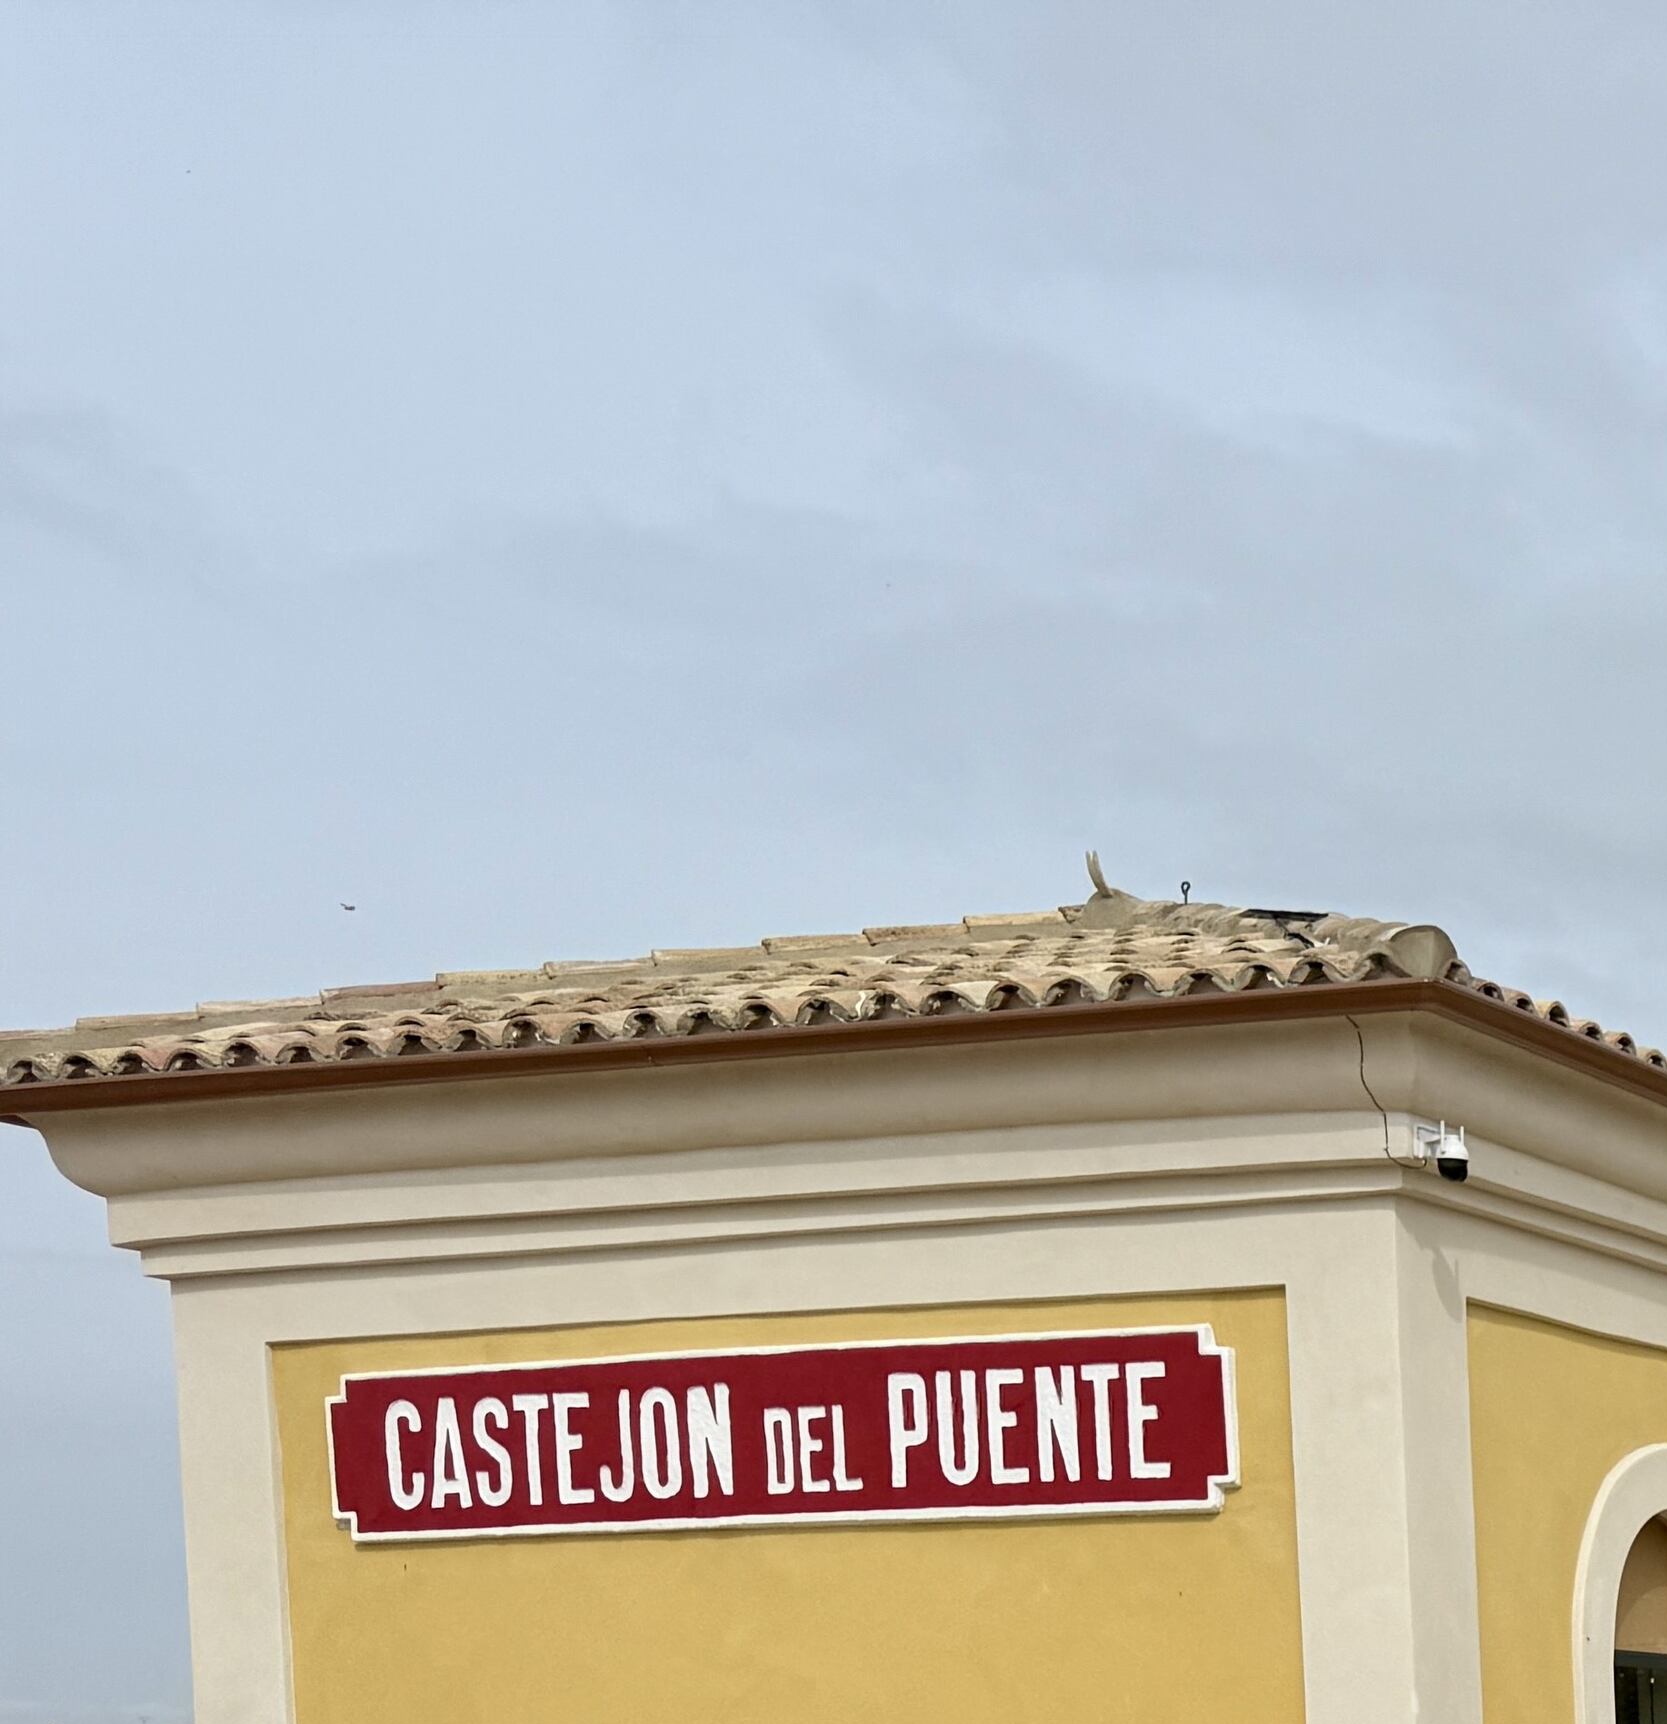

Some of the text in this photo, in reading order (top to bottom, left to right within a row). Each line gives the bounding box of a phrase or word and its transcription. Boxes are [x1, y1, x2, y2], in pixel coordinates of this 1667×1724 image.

[385, 1362, 1170, 1510] CASTEJON DEL PUENTE
